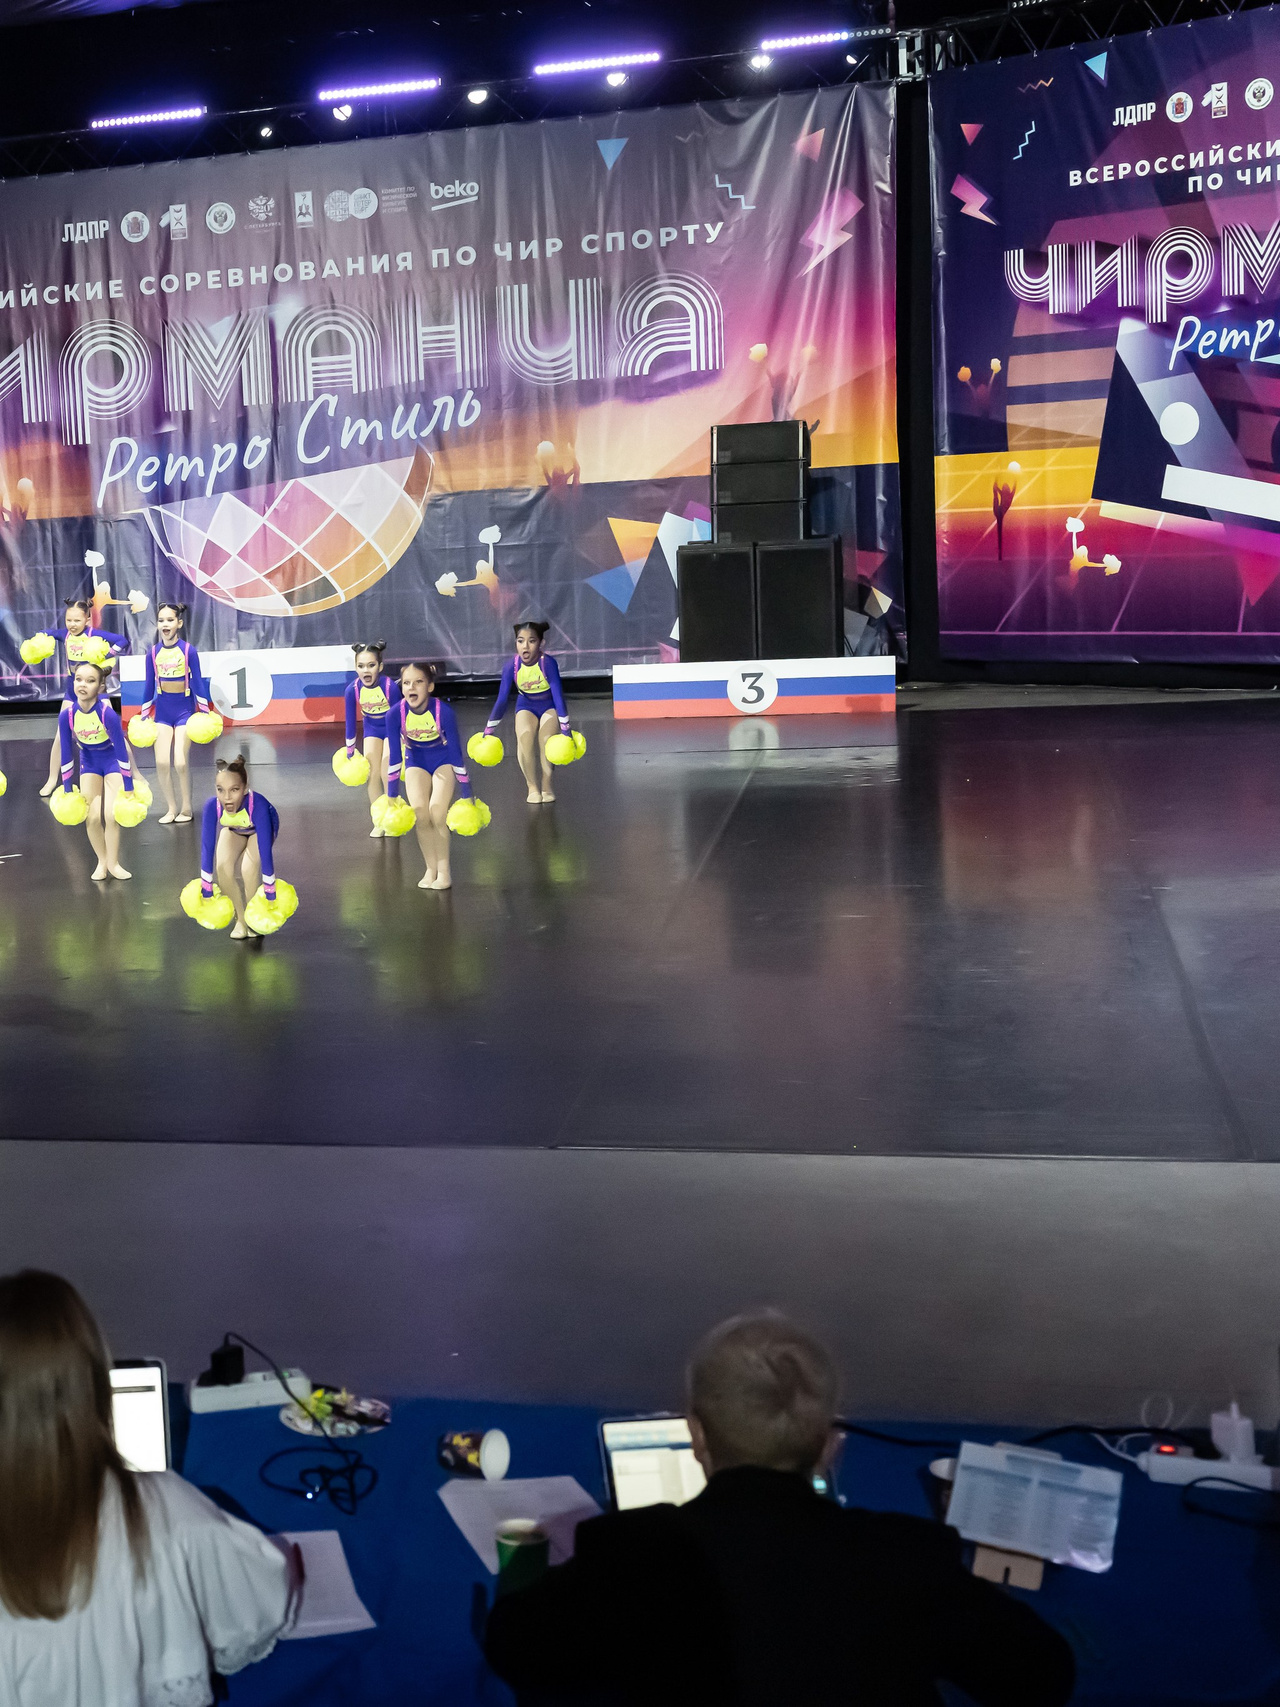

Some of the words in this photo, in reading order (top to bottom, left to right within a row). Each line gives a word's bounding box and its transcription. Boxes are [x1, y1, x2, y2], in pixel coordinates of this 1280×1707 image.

[1113, 102, 1156, 127] ЛДПР
[1069, 139, 1280, 187] ВСЕРОССИЙСКИ
[1188, 172, 1224, 193] ПО
[1236, 163, 1280, 185] ЧИ
[430, 179, 480, 199] beko
[62, 220, 110, 244] ЛДПР
[139, 251, 413, 295] СОРЕВНОВАНИЯ
[431, 245, 477, 268] ПО
[494, 238, 564, 262] ЧИР
[581, 221, 725, 254] СПОРТУ
[1168, 315, 1280, 371] Ретр
[97, 434, 271, 508] Ретро
[297, 389, 482, 464] Стиль
[229, 667, 253, 708] 1
[741, 672, 765, 704] 3
